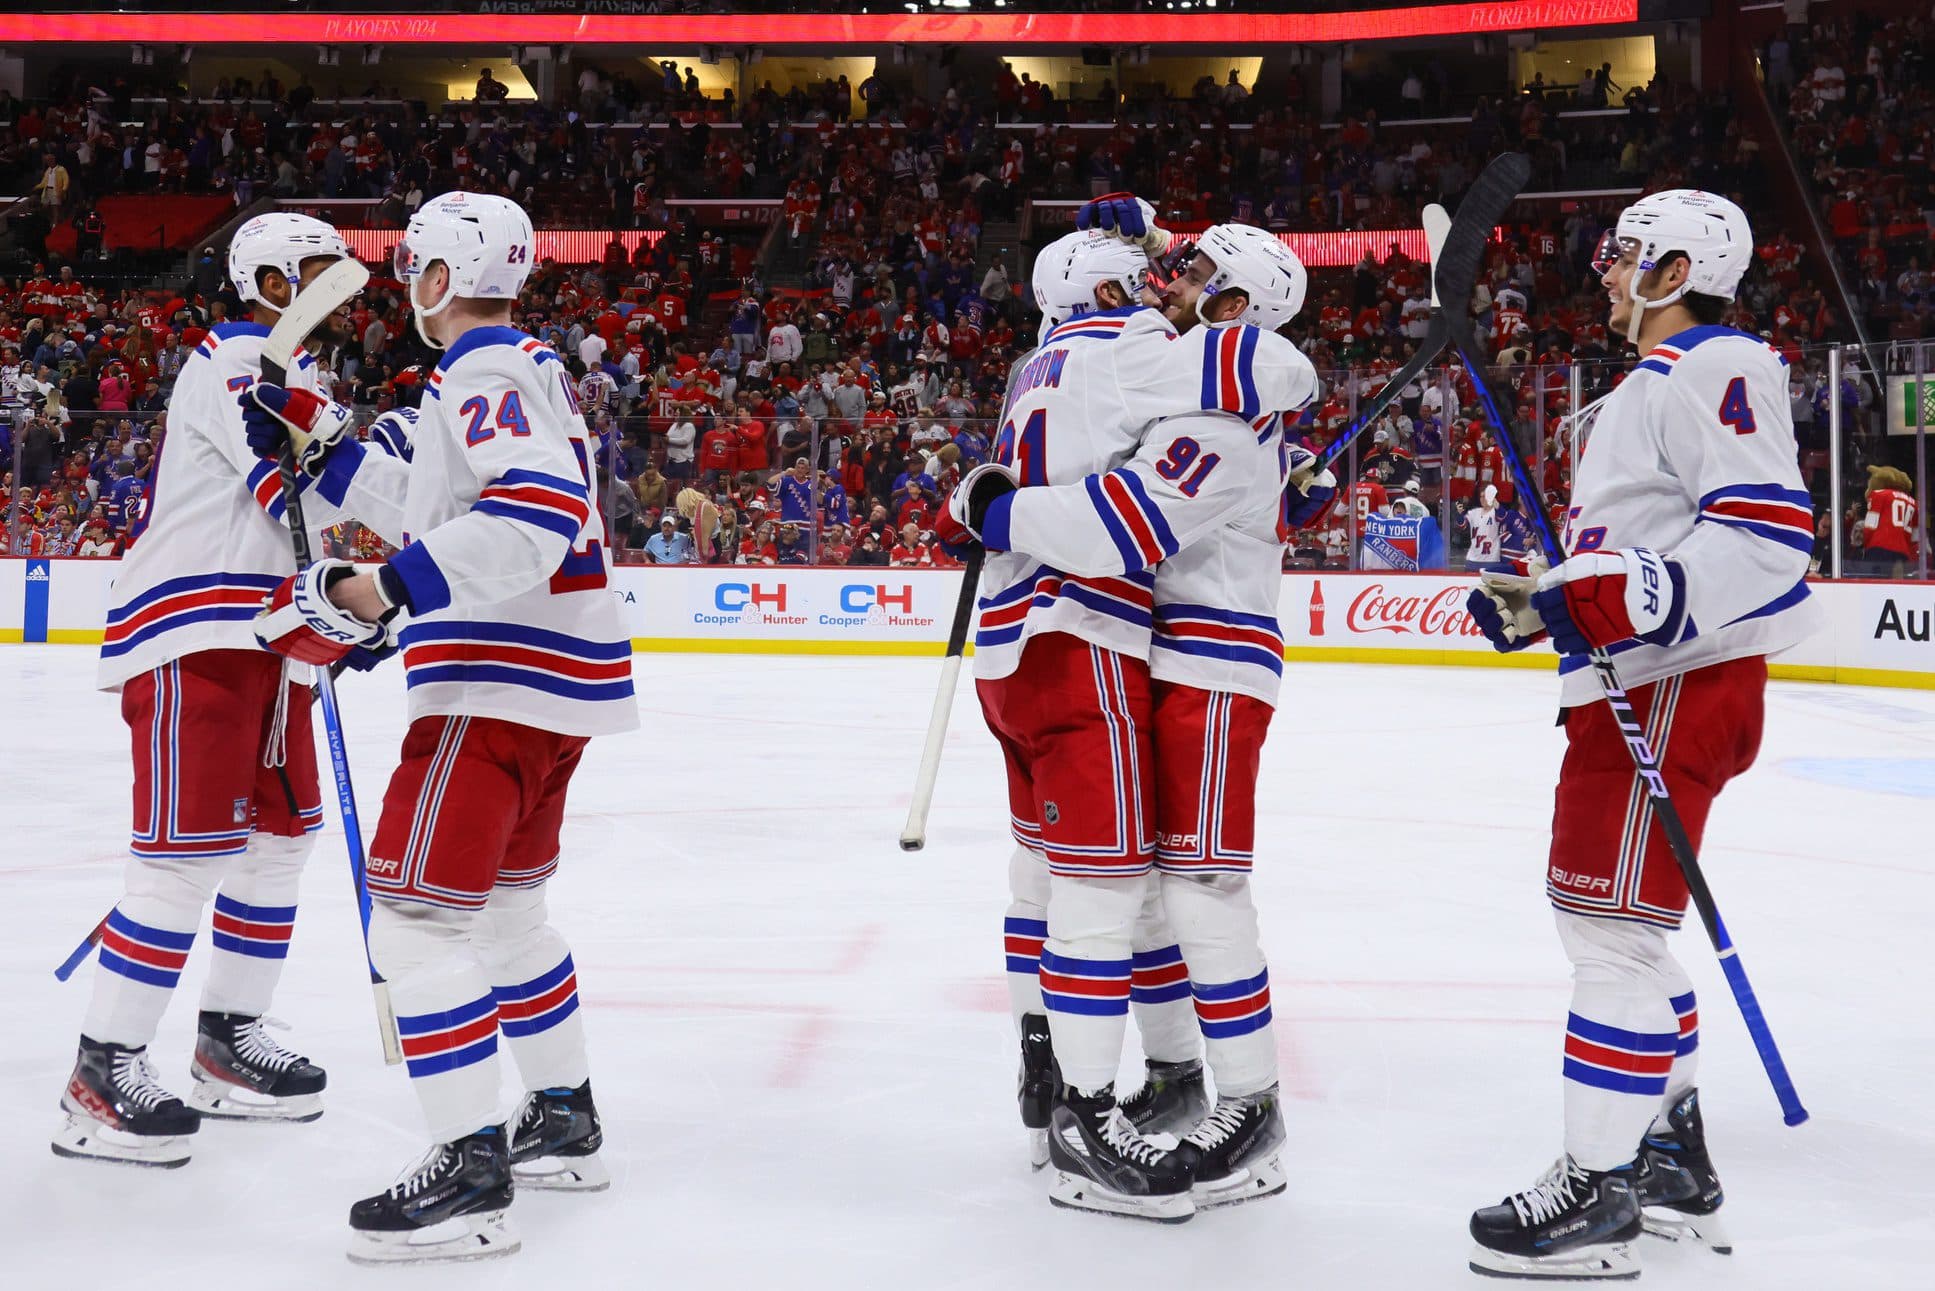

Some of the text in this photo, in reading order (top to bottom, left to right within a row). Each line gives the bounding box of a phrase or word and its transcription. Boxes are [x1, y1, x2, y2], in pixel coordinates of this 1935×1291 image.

[1471, 0, 1634, 27] FLORIDA PANTHERS
[324, 19, 436, 37] PLAYOFFS 2024
[507, 244, 527, 264] 24
[664, 301, 674, 316] 5
[1718, 376, 1757, 436] 4
[458, 390, 532, 448] 24
[1155, 436, 1221, 499] 91
[1366, 521, 1416, 537] NEW YORK
[1486, 516, 1493, 525] A
[1471, 527, 1493, 555] NYR
[1371, 537, 1416, 572] RANGERS
[694, 612, 741, 626] Cooper
[763, 613, 809, 625] Hunter
[819, 614, 867, 628] Cooper
[888, 615, 934, 626] Hunter
[1873, 599, 1935, 642] Au
[329, 730, 352, 816] HYPERLITE
[1155, 832, 1199, 849] AUER
[230, 1061, 263, 1082] CCM
[1550, 1219, 1588, 1239] BAUER
